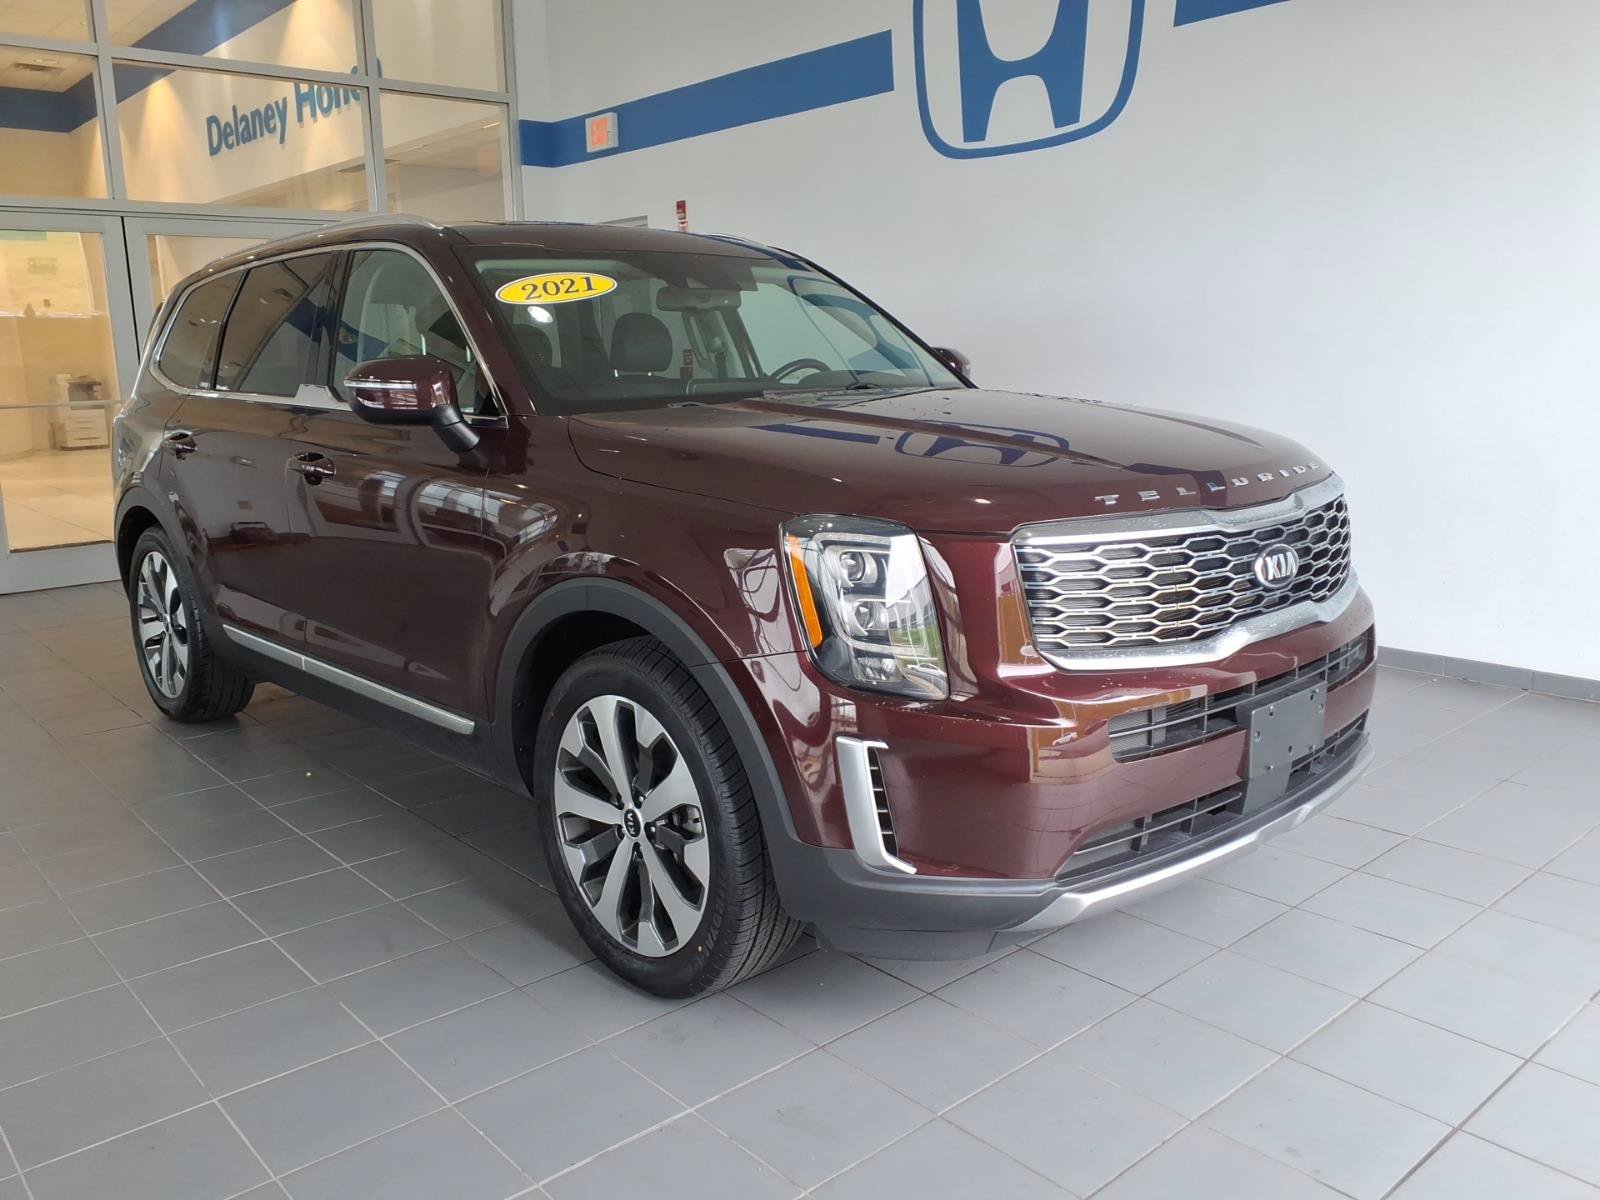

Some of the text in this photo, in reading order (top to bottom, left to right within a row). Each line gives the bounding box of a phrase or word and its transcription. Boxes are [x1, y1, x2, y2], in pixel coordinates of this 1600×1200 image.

[206, 97, 288, 156] Delaney
[521, 276, 598, 301] 2021
[1093, 462, 1320, 506] TELLURIDE
[1265, 550, 1297, 581] KIA
